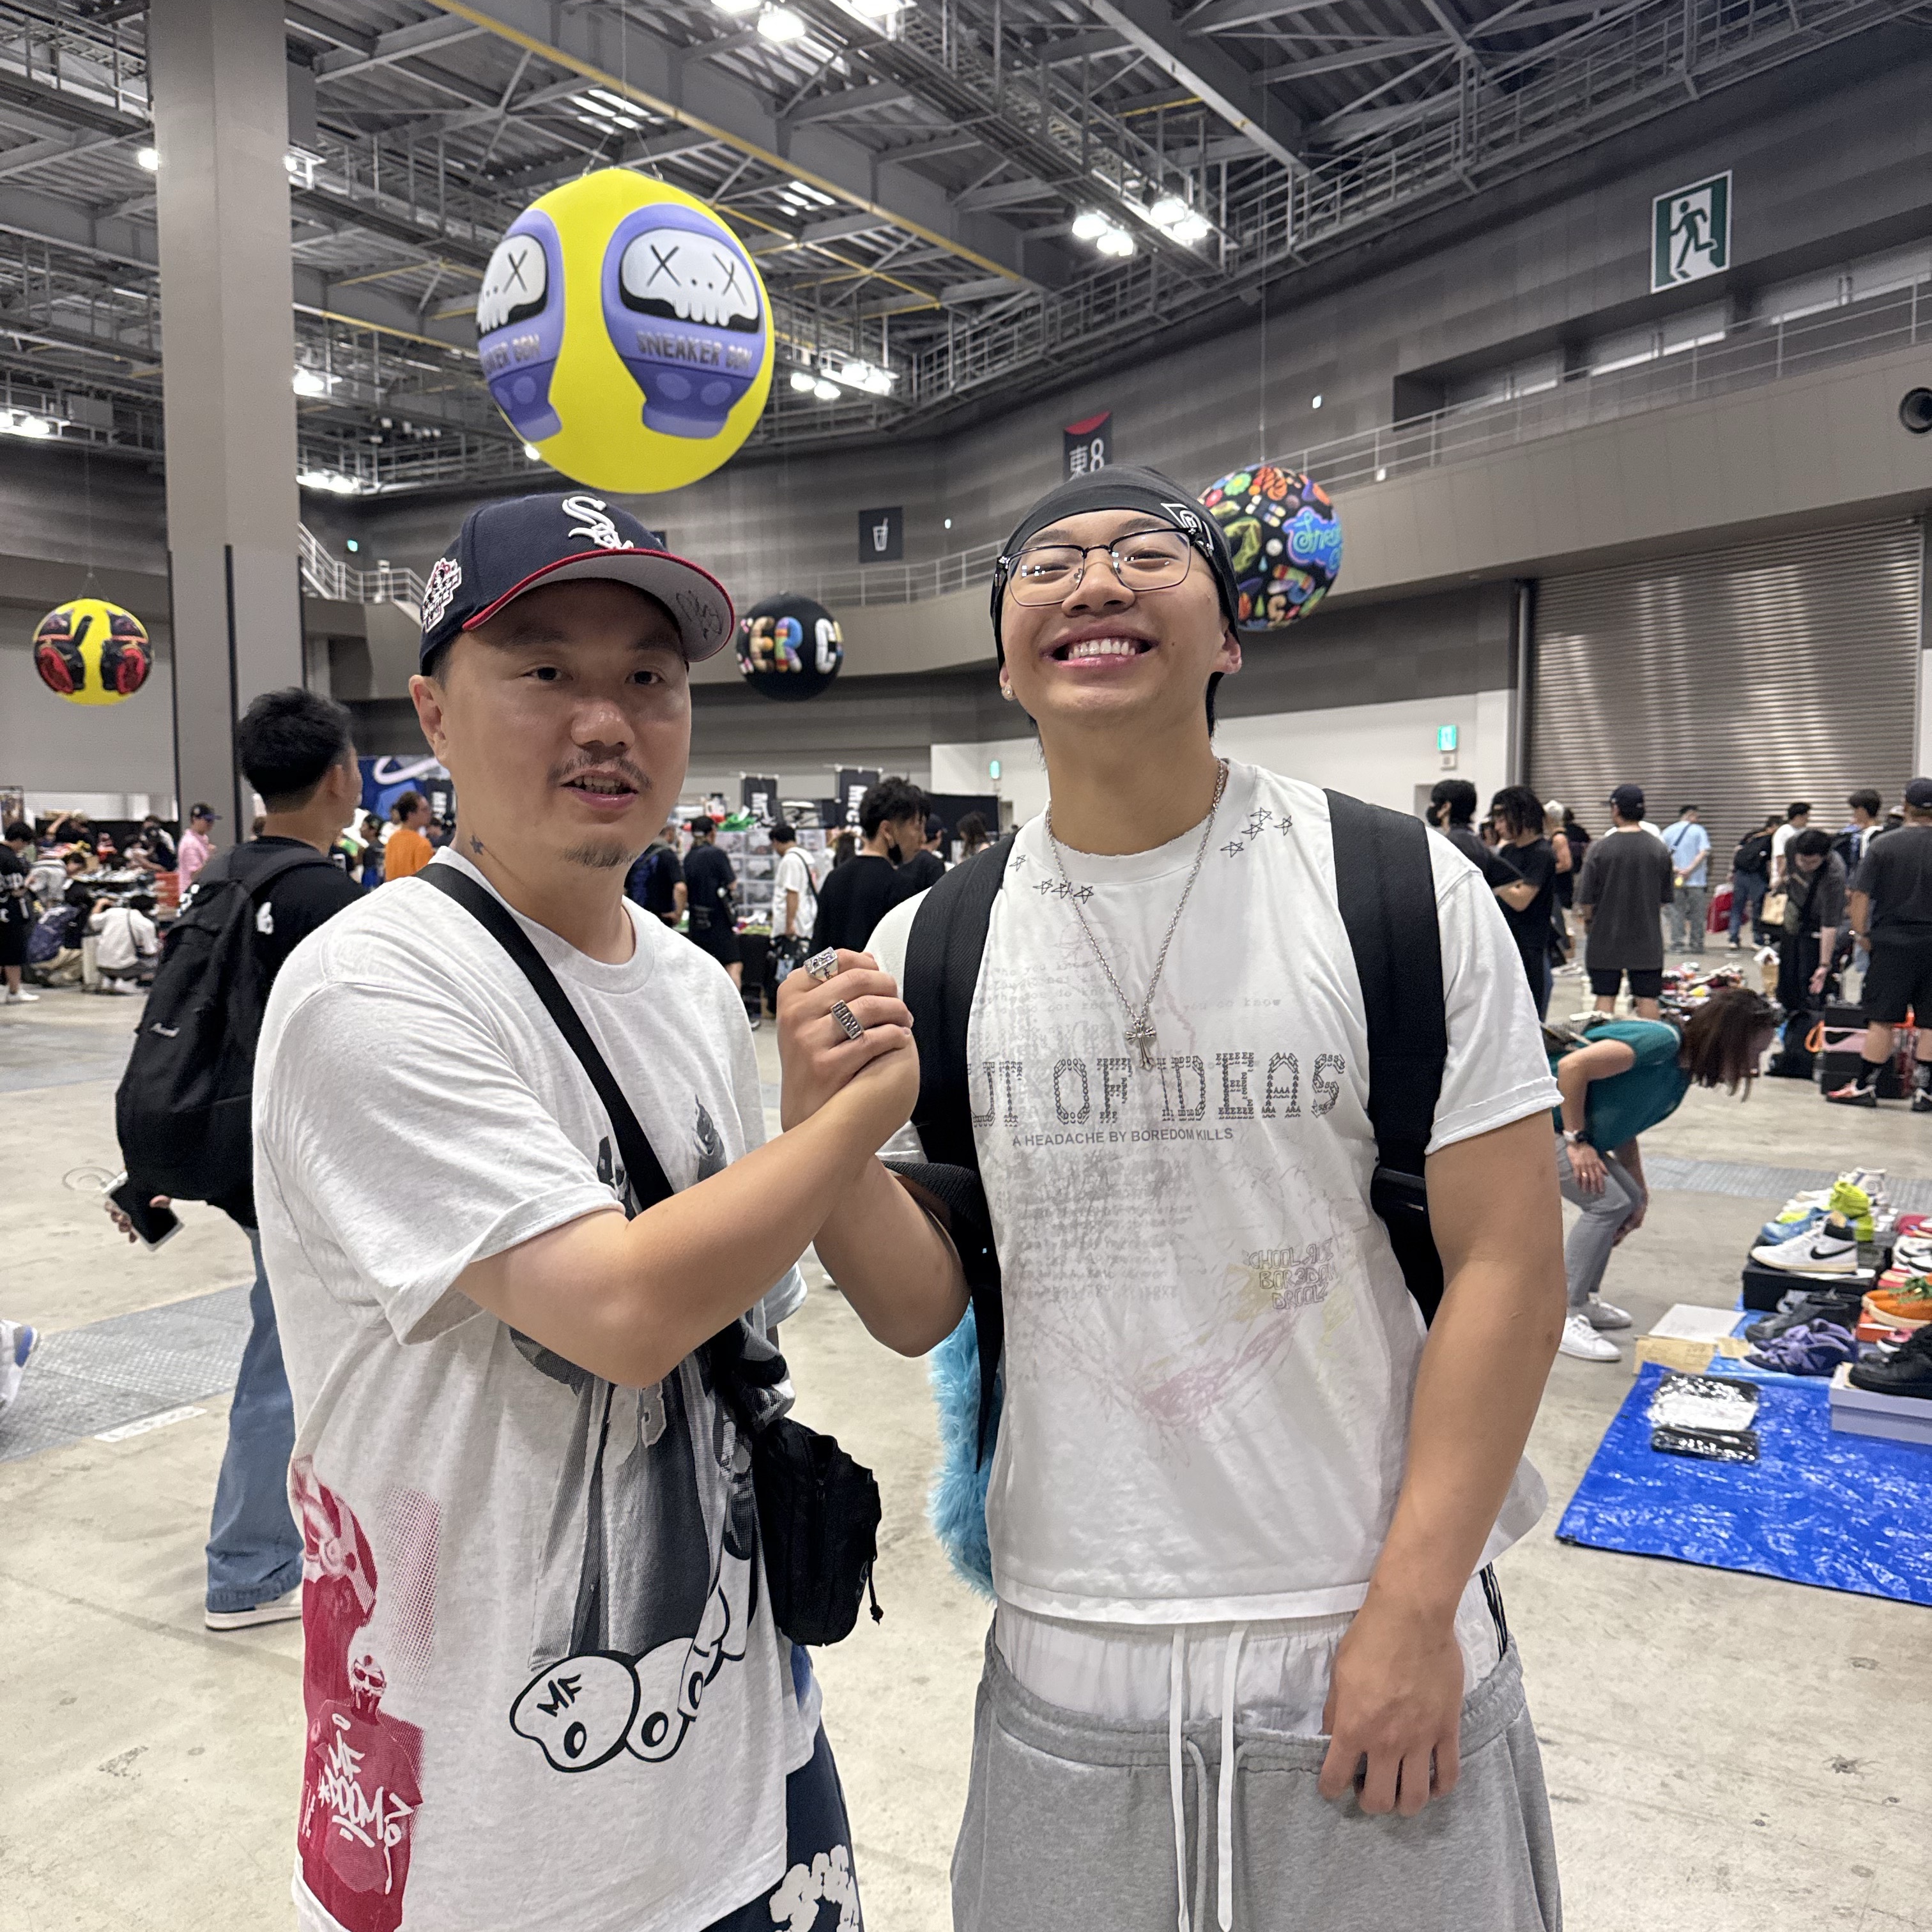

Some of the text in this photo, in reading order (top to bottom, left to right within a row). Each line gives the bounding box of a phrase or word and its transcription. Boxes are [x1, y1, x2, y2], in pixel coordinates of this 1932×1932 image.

[636, 330, 722, 365] SNEAKER
[1053, 1057, 1133, 1125] OF
[1156, 1051, 1346, 1123] IDEAS
[1012, 1128, 1234, 1147] A HEADACHE BY BOREDOM KILLS
[537, 1673, 582, 1718] MF
